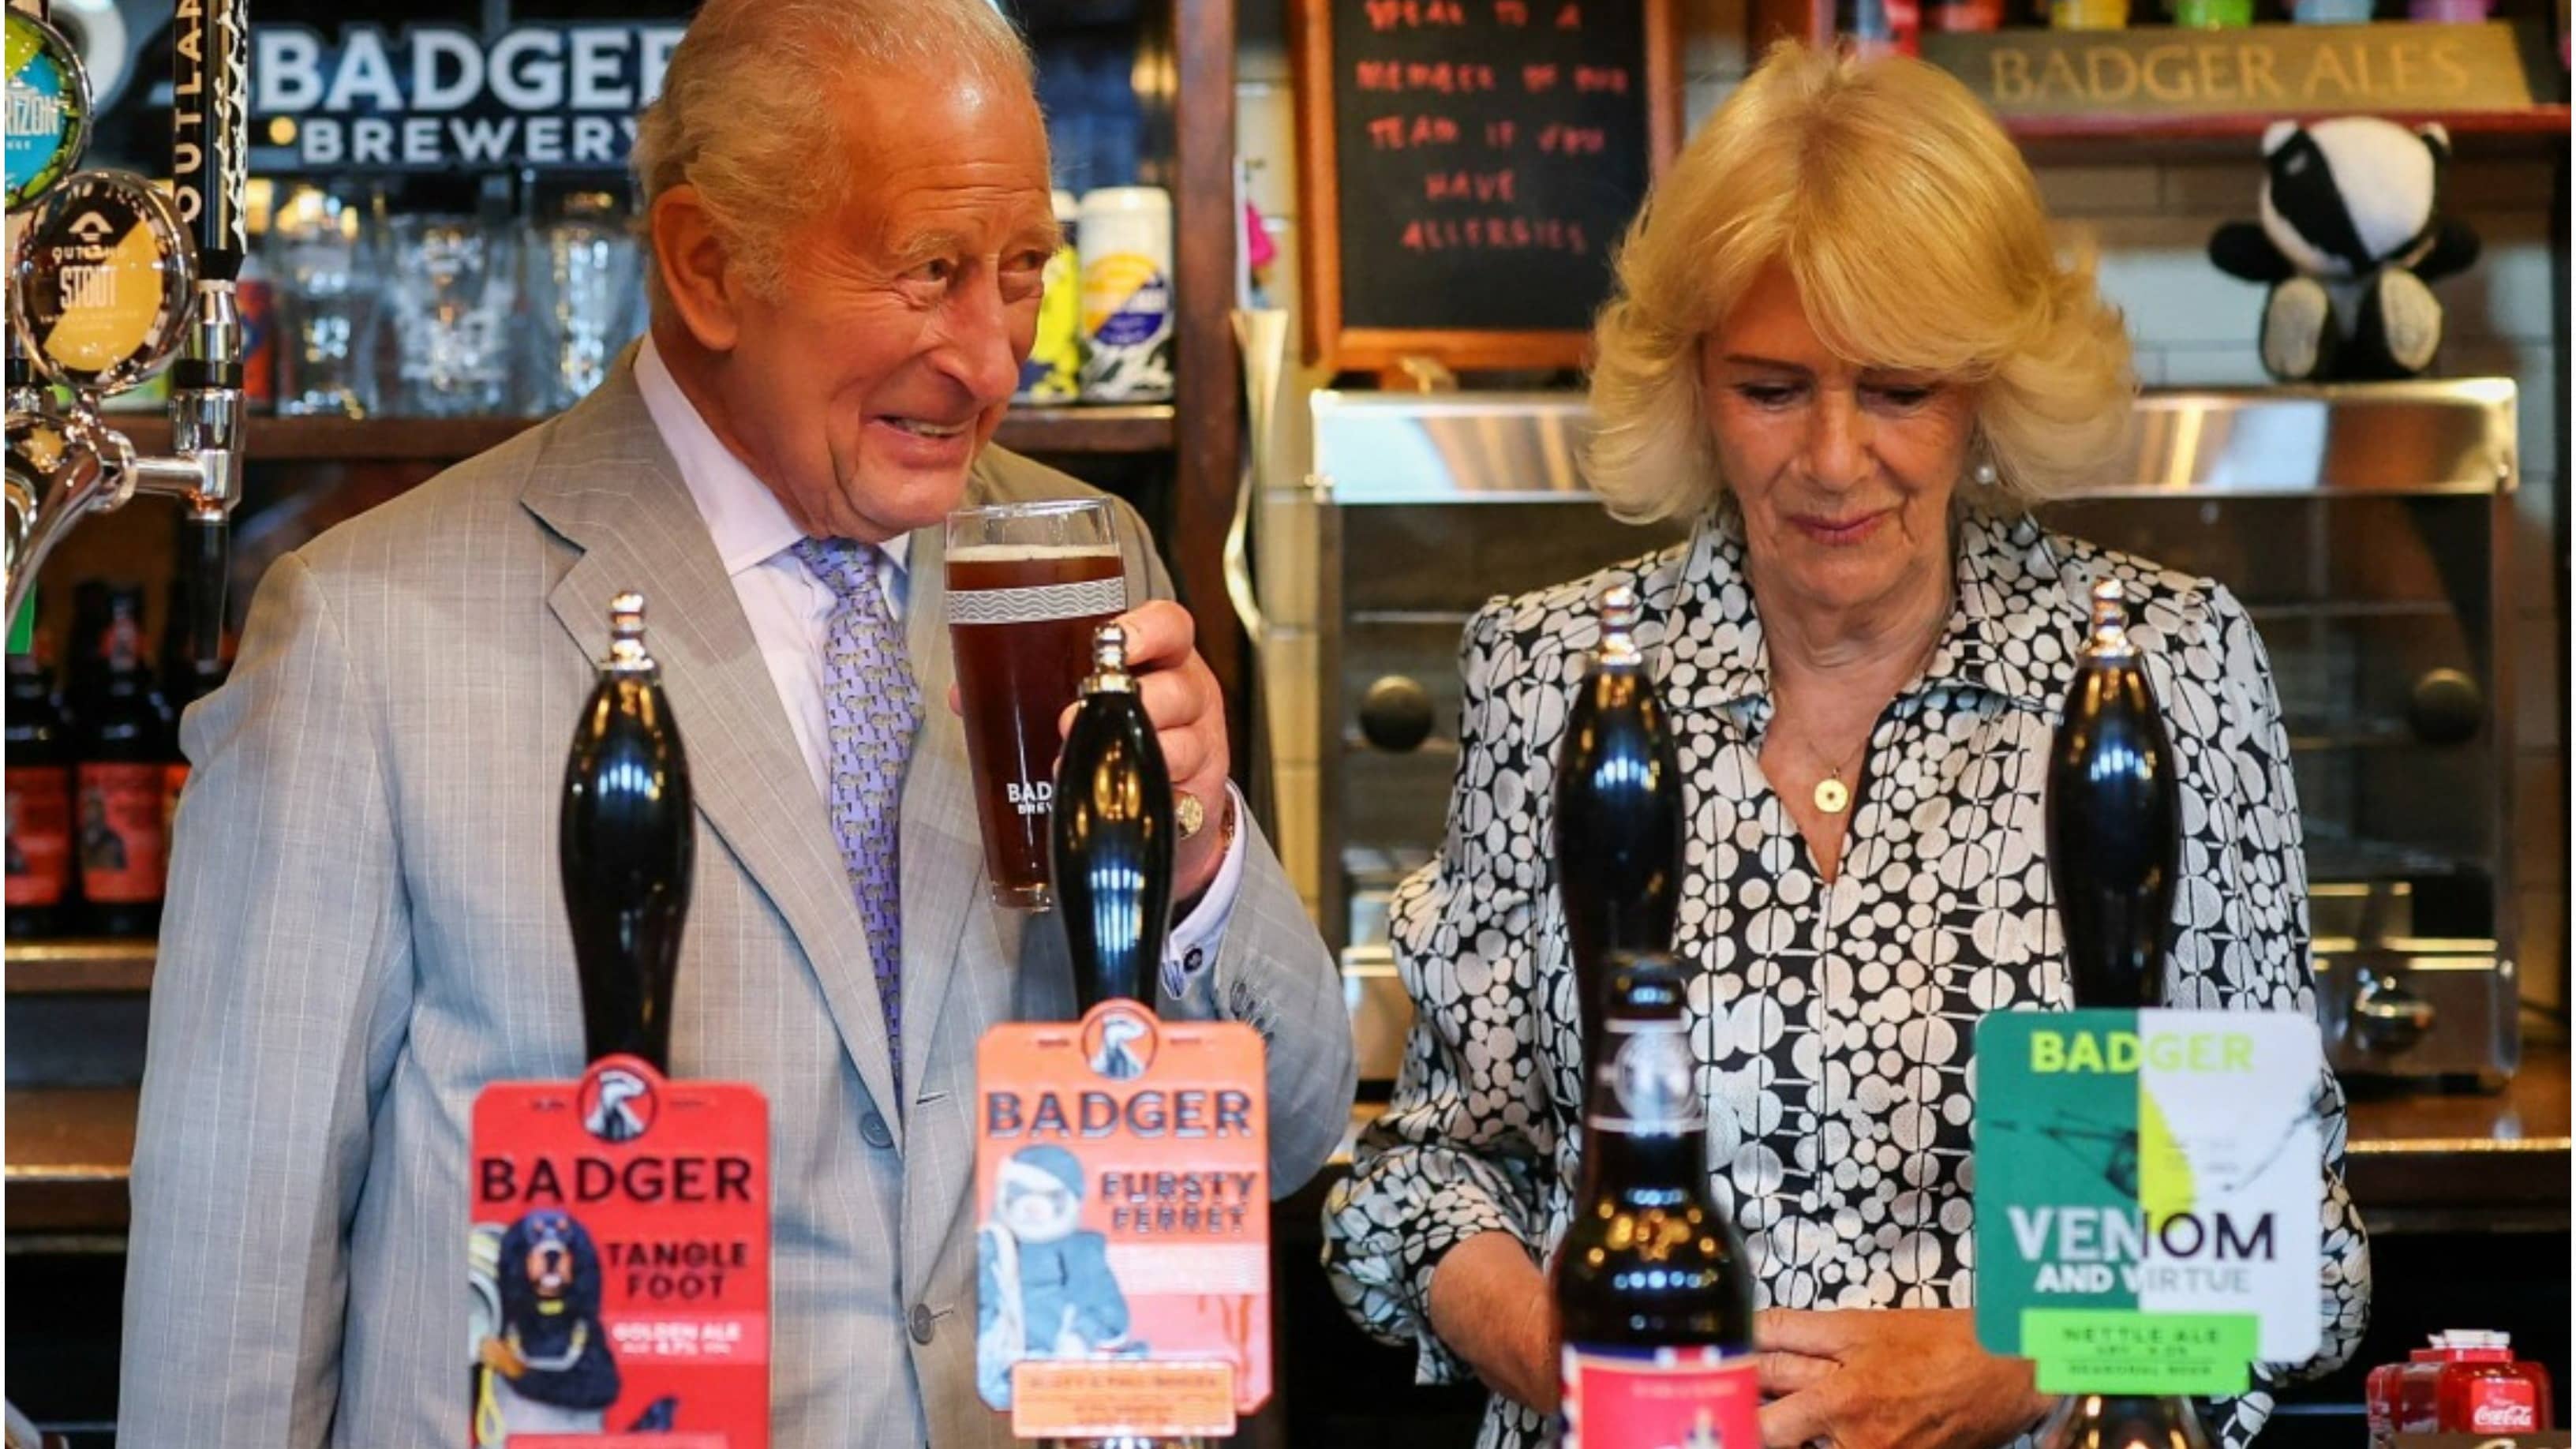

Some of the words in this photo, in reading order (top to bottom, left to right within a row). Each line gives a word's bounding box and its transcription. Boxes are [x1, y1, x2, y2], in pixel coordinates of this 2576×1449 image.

[1990, 45, 2278, 102] BADGER
[2303, 44, 2470, 95] ALES
[301, 116, 641, 164] BREWER
[1425, 170, 1515, 201] HAVE
[59, 265, 118, 309] STOUT
[2030, 1032, 2254, 1073] BADGER
[987, 1090, 1253, 1138] BADGER
[480, 1157, 751, 1202] BADGER
[1102, 1172, 1256, 1204] FURSTY
[2007, 1206, 2277, 1261] VENOM
[607, 1243, 748, 1266] TANGLE
[627, 1275, 726, 1300] FOOT
[2034, 1267, 2114, 1294] AND
[2122, 1267, 2251, 1294] VIRTUE
[701, 1322, 741, 1342] ALE
[2062, 1327, 2162, 1343] NETTLE
[2176, 1327, 2220, 1343] ALE
